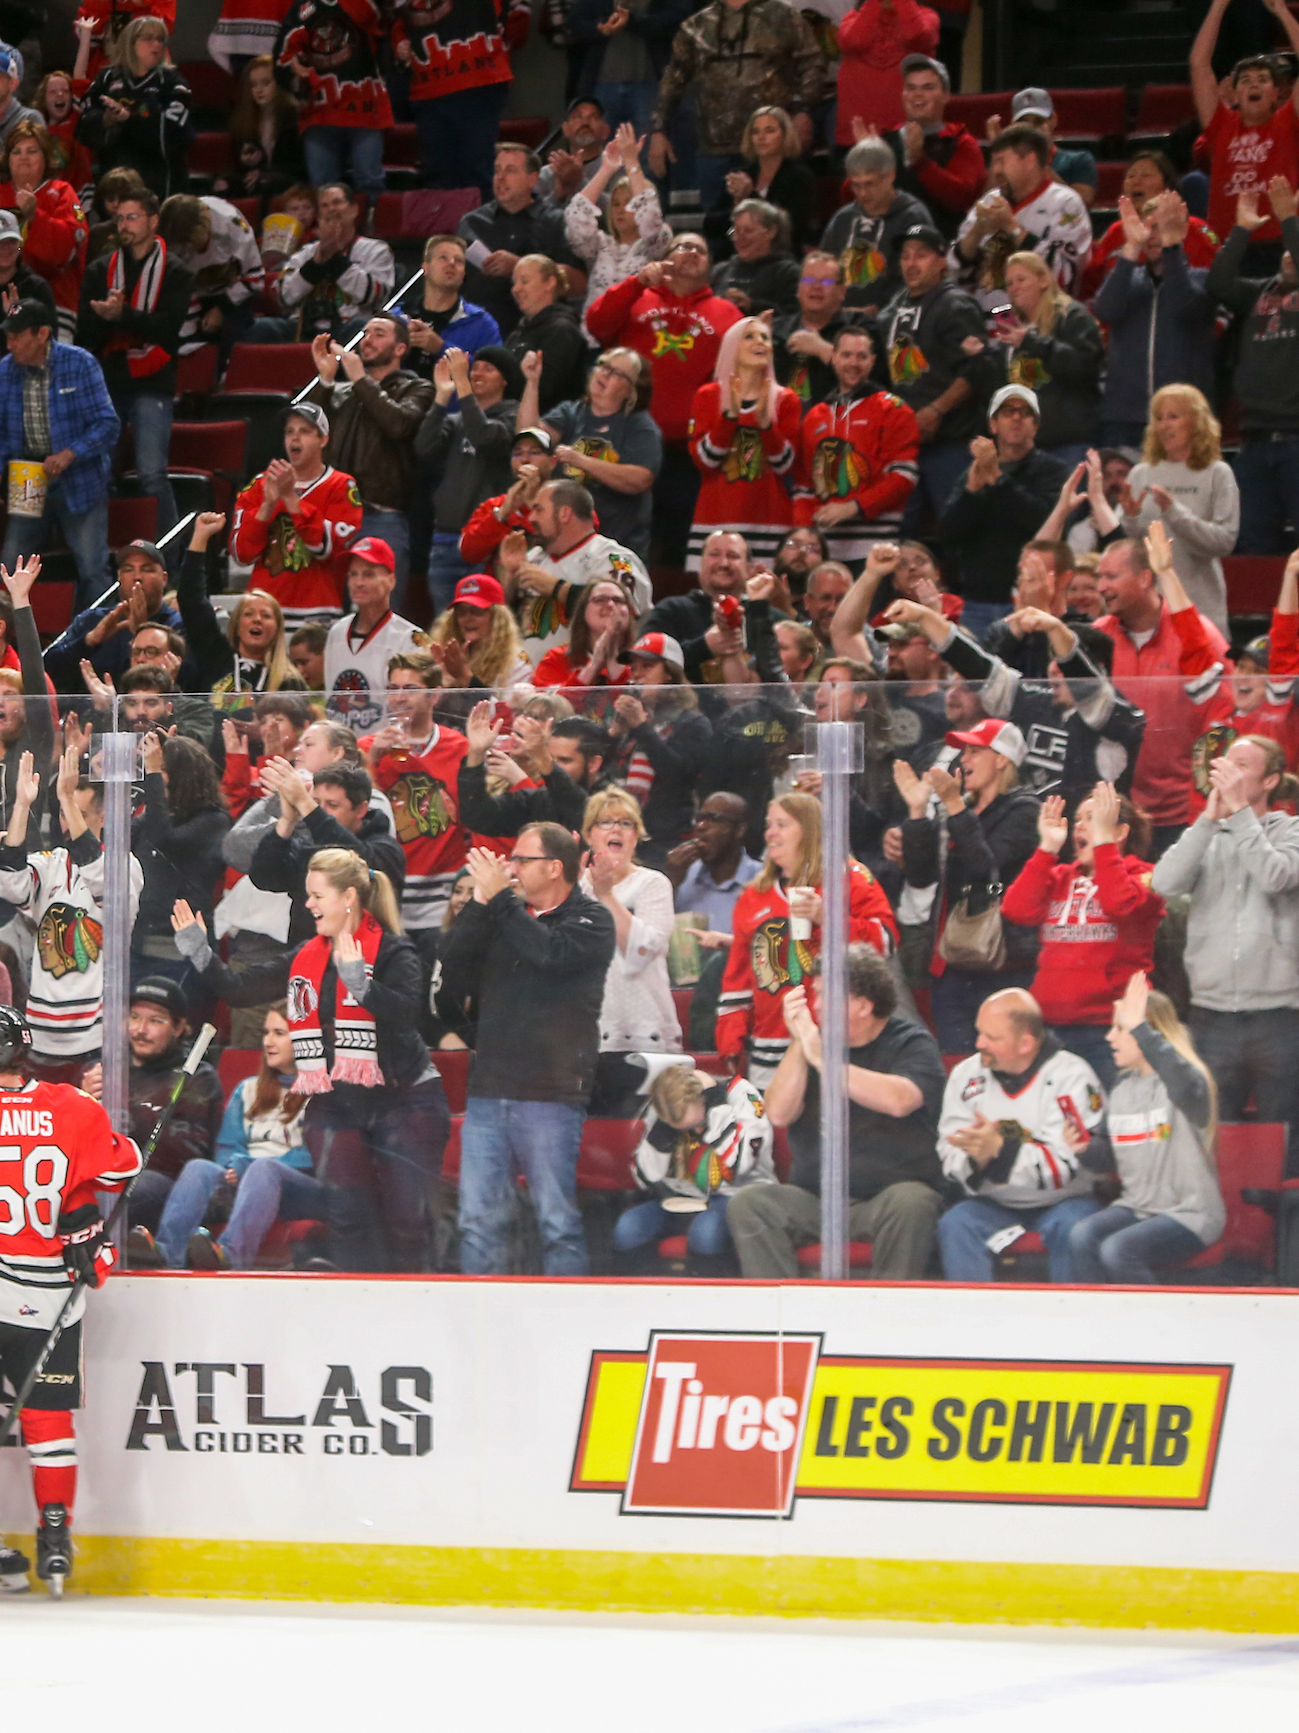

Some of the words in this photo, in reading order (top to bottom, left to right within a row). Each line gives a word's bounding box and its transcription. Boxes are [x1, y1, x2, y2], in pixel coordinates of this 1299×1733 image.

[0, 1096, 34, 1105] CCM
[125, 1361, 434, 1457] ATLAS
[194, 1431, 306, 1455] CIDER
[323, 1434, 380, 1456] CO.
[652, 1361, 798, 1464] Tires
[814, 1395, 913, 1459] LES
[927, 1397, 1195, 1468] SCHWAB
